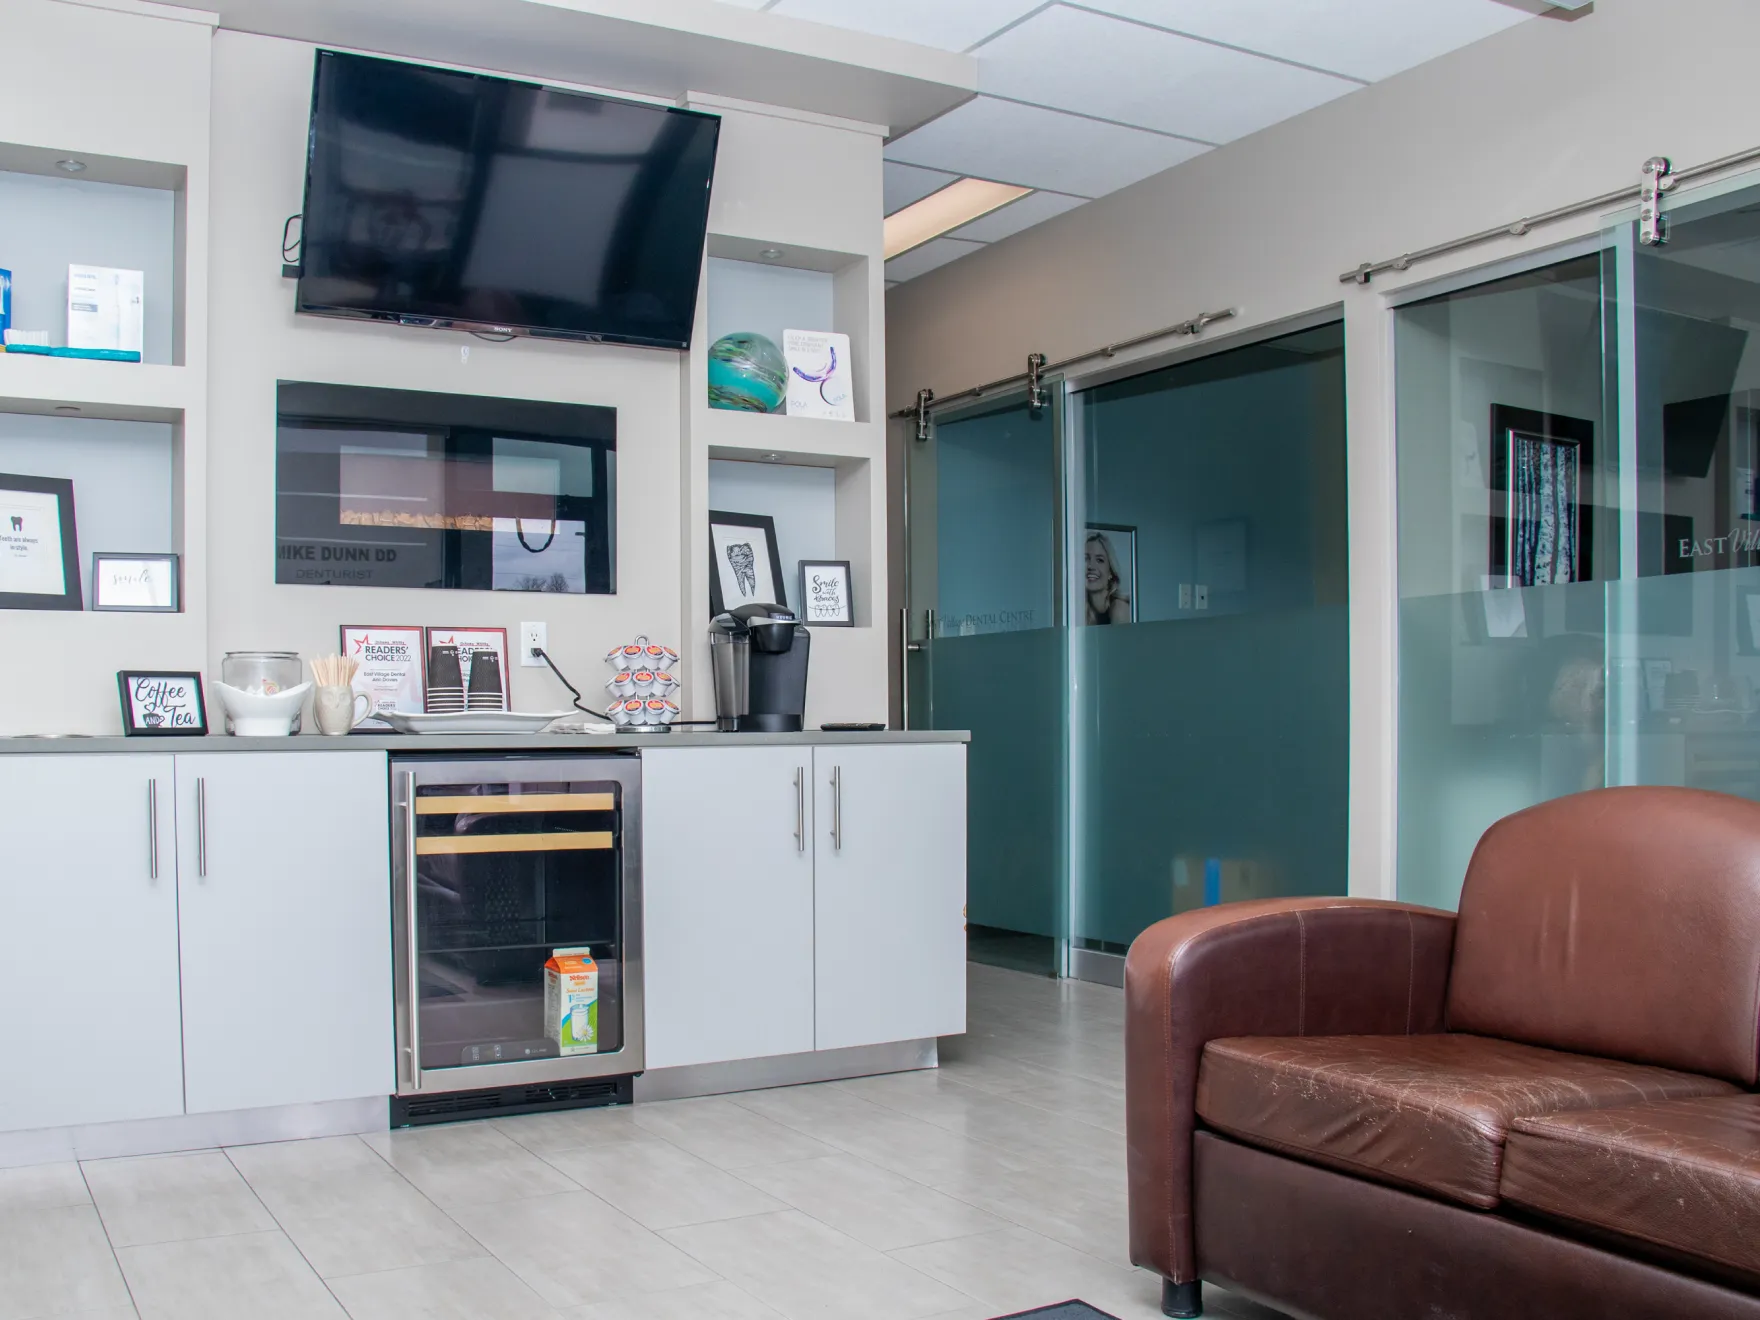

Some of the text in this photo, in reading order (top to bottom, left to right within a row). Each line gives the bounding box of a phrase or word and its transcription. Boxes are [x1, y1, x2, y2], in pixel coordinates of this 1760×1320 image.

[321, 546, 371, 562] DUNN
[375, 548, 397, 562] DD
[1678, 538, 1727, 557] EAST
[295, 568, 374, 580] DENTURIST
[812, 574, 840, 594] Smile
[965, 613, 997, 627] DENTAL
[998, 609, 1037, 624] CENTRE
[365, 654, 412, 662] CHOICE 2022
[135, 676, 186, 709] Coffee
[145, 714, 160, 725] AND
[163, 703, 196, 729] Tea
